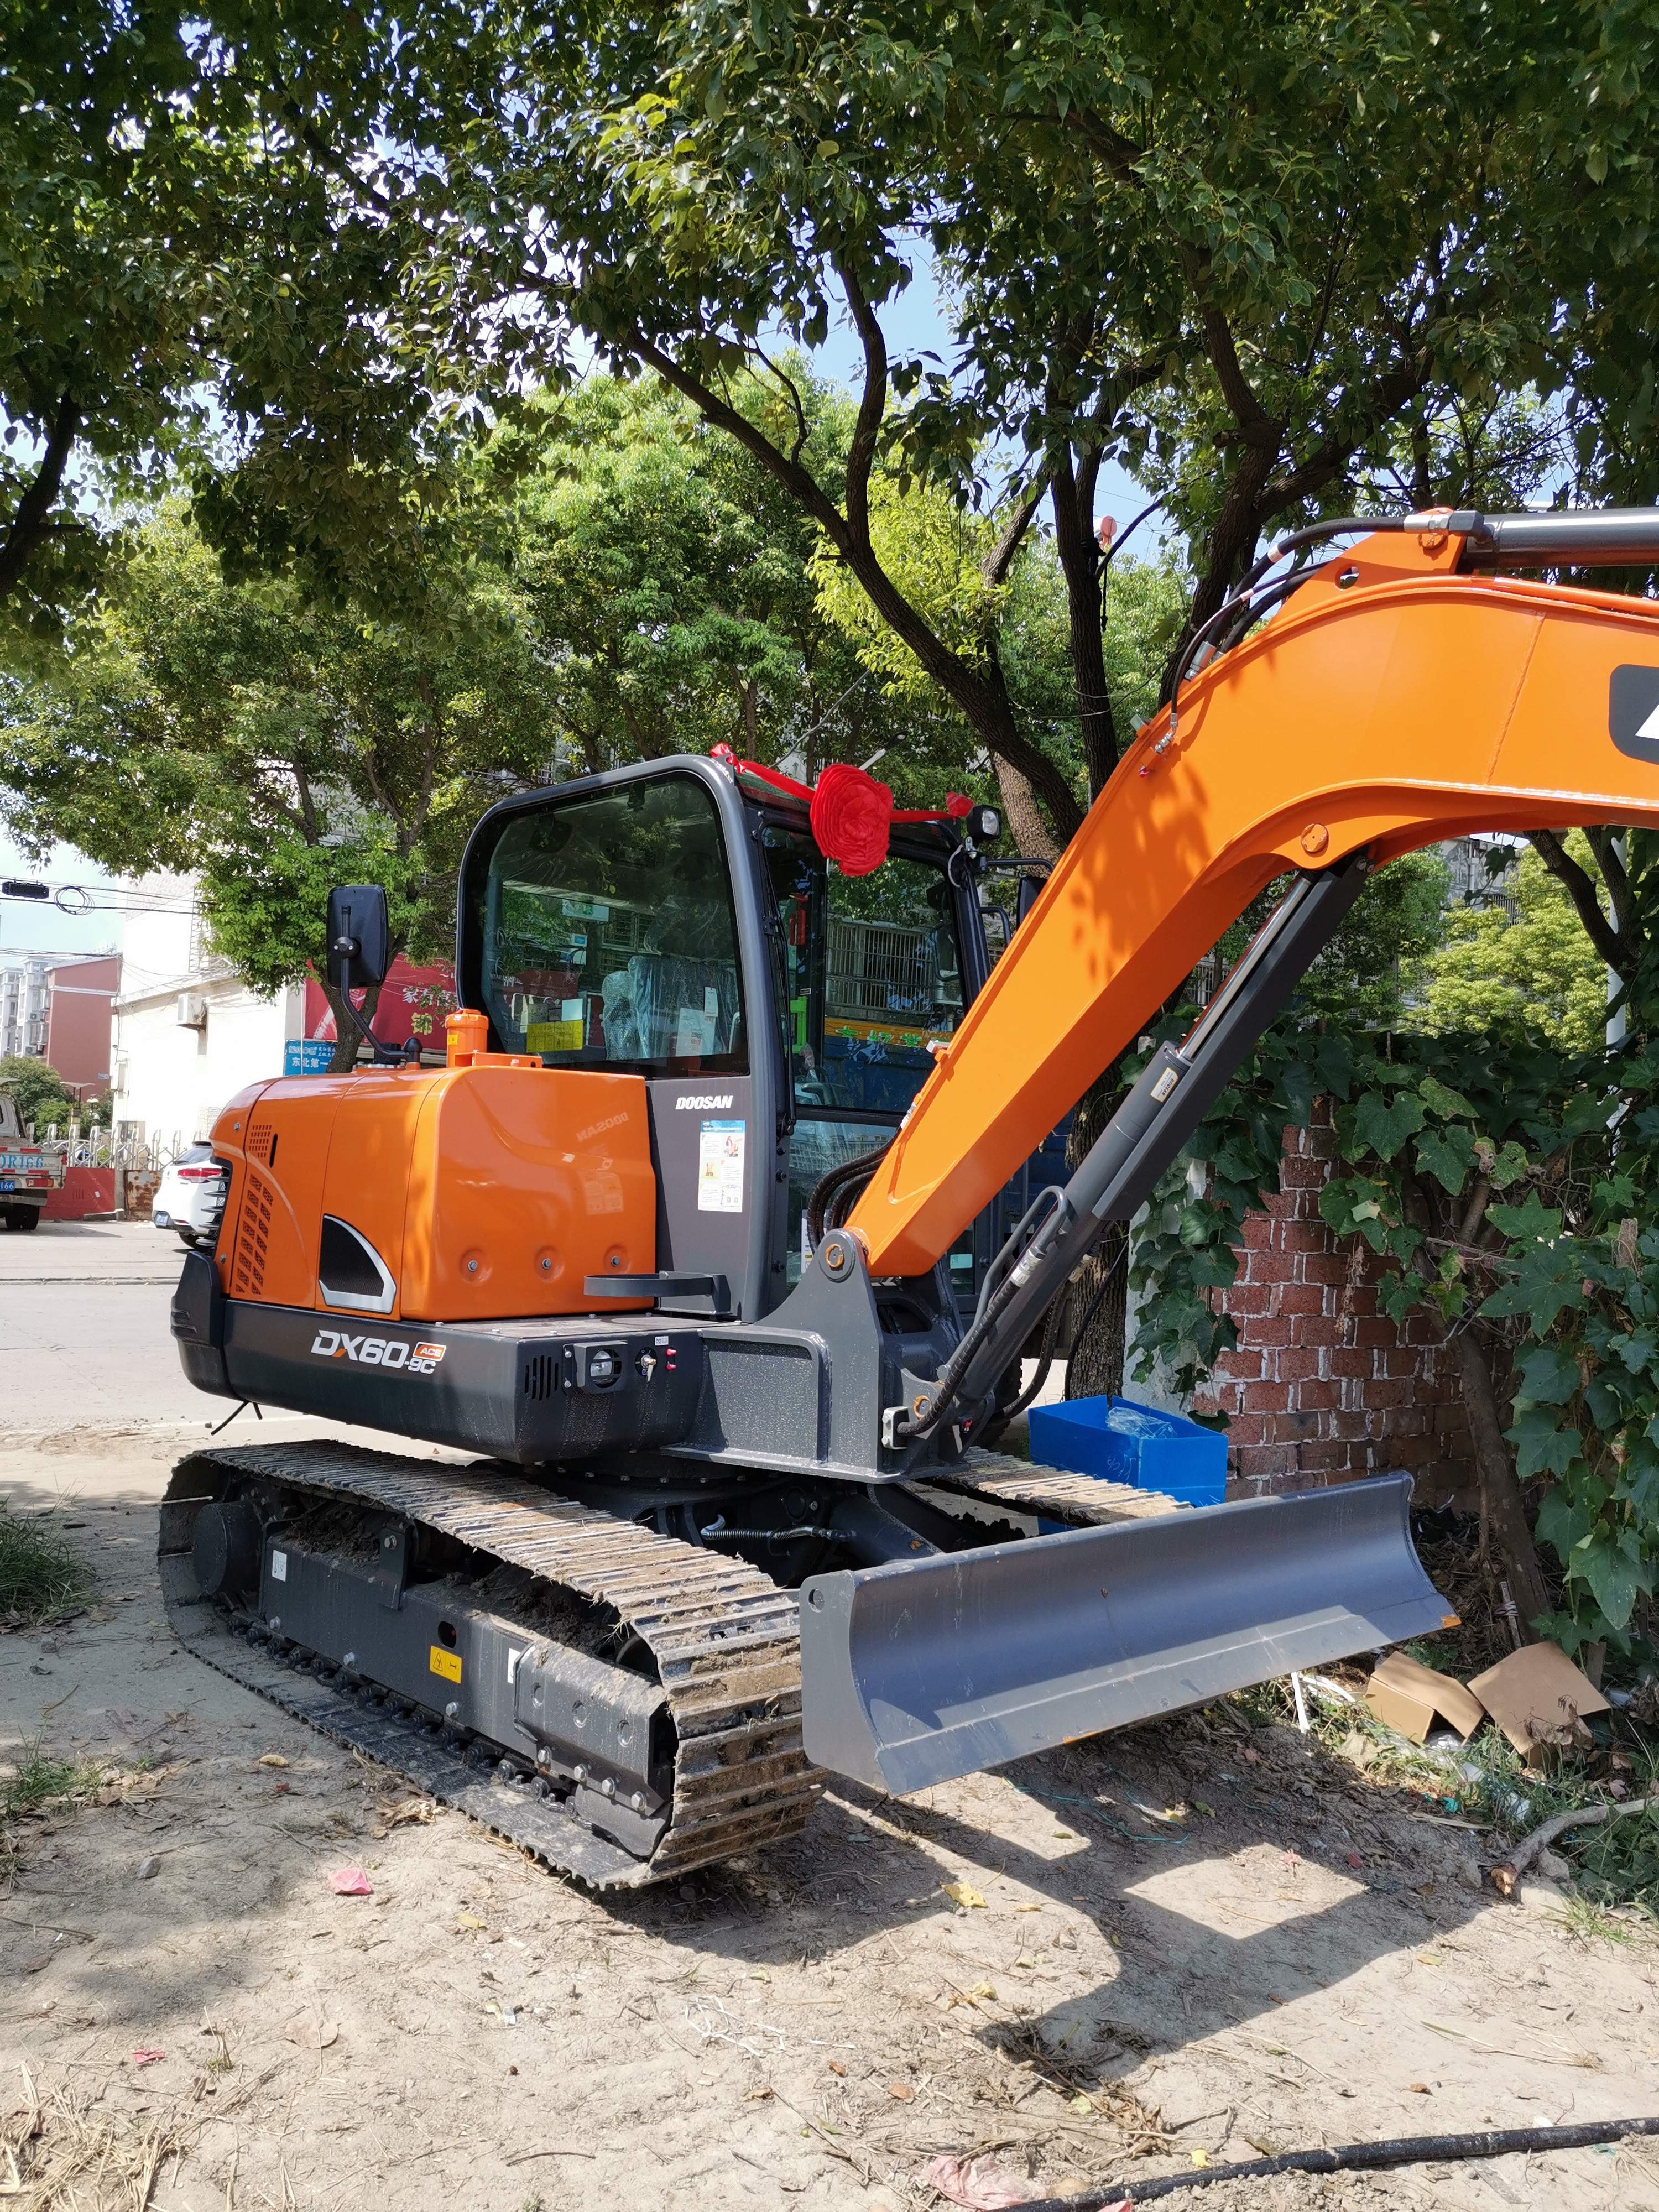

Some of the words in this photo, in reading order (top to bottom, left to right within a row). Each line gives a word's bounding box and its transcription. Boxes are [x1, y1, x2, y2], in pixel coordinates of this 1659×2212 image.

[292, 1057, 331, 1068] 东北第一
[675, 1095, 733, 1109] DOOSAN
[1, 1181, 14, 1190] 166
[420, 1347, 442, 1357] ACE
